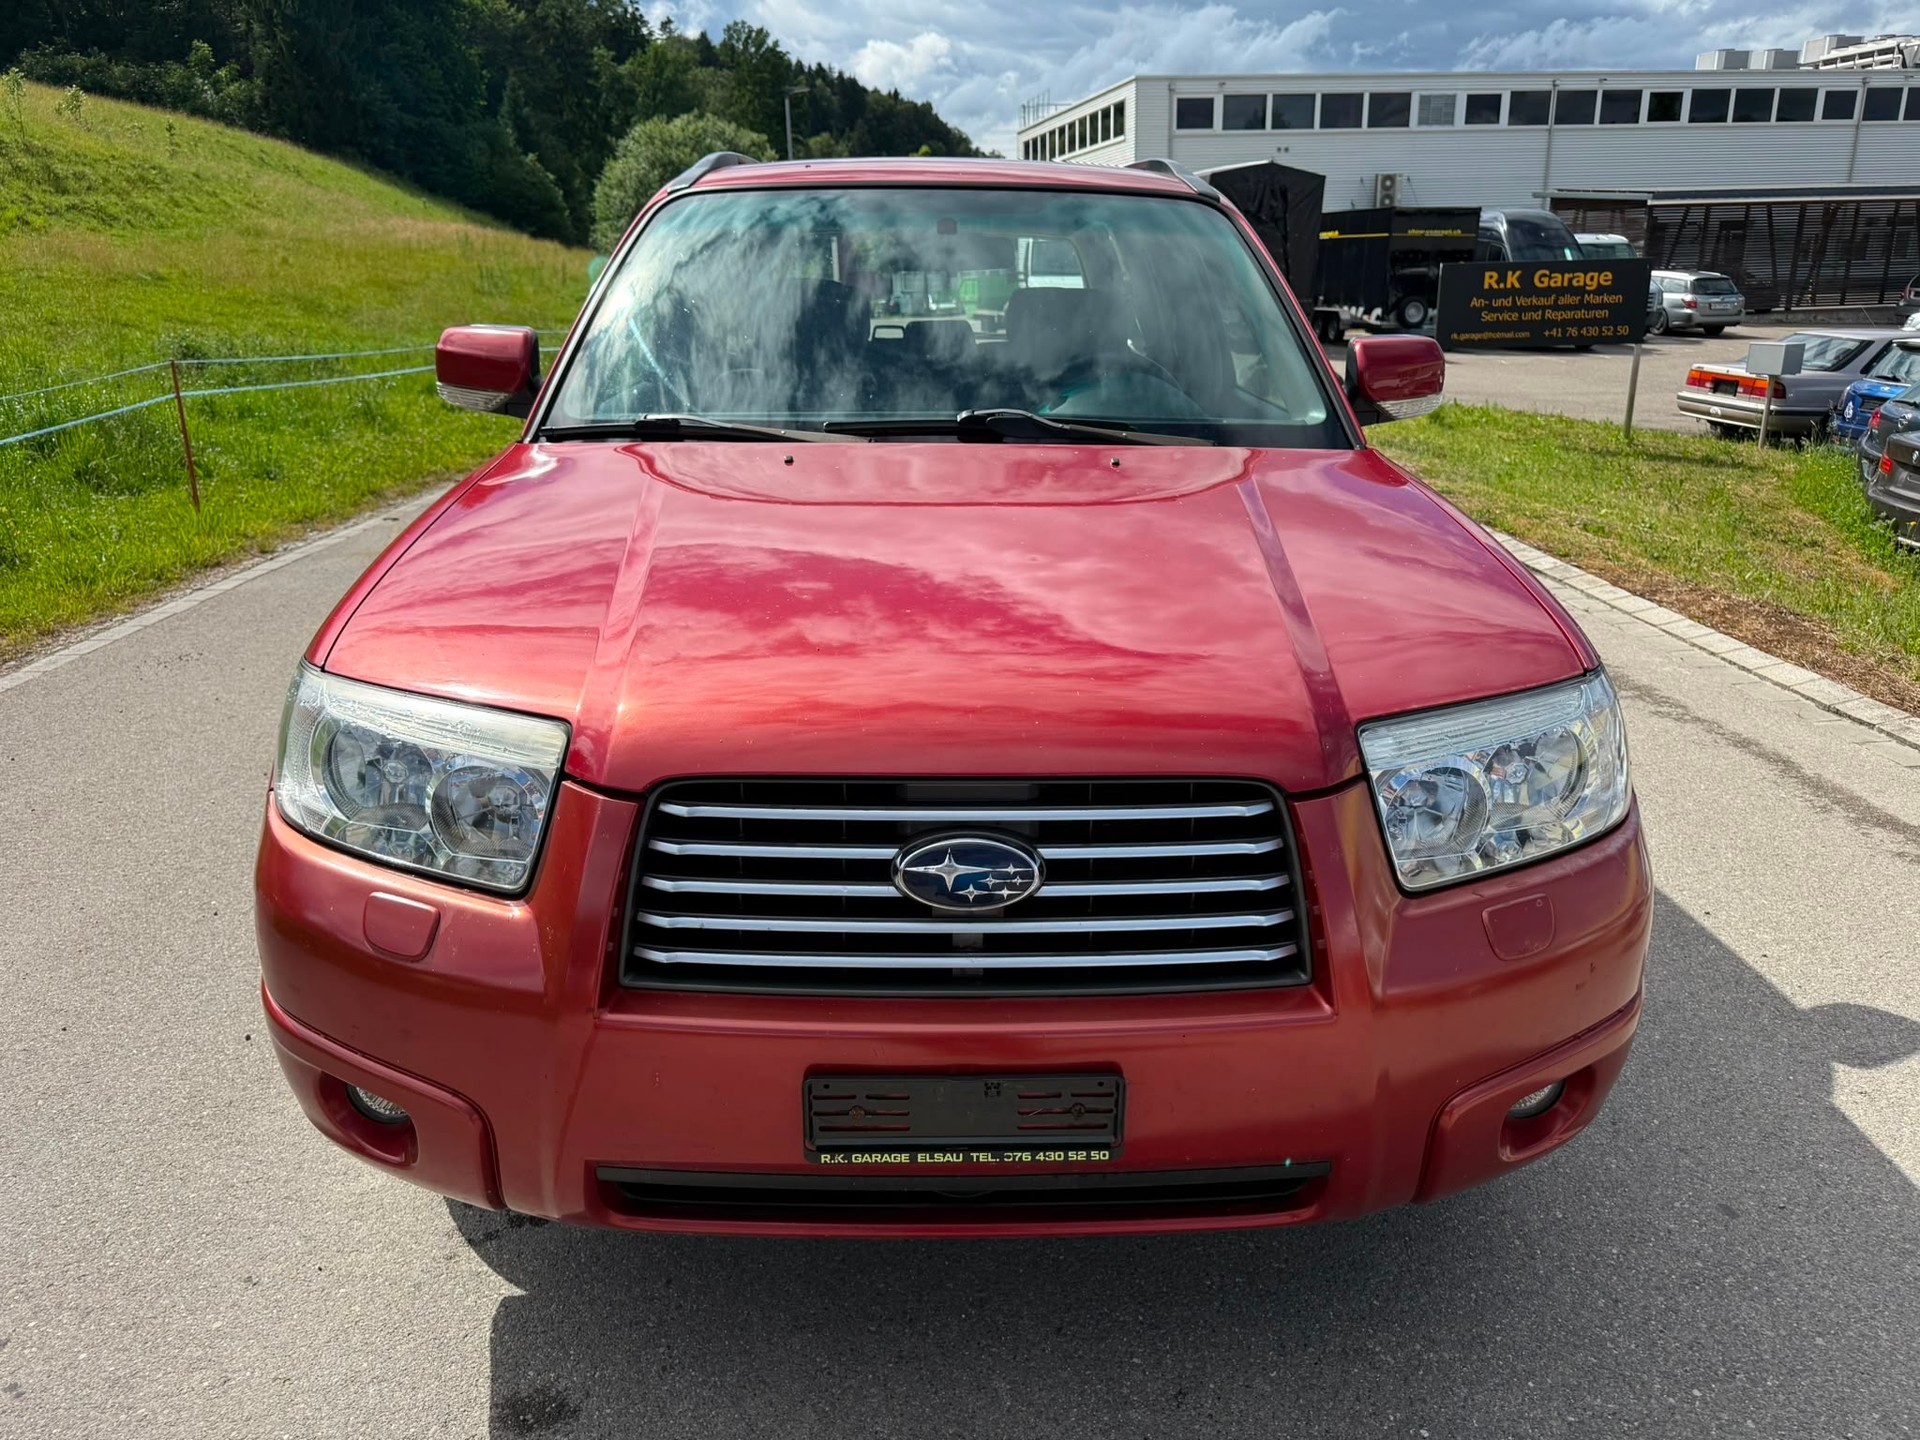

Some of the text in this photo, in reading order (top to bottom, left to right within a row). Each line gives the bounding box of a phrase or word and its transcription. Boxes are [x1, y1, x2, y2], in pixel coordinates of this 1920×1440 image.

[1484, 269, 1613, 290] R.K Garage
[1470, 292, 1623, 308] An- und Verkauf aller Marken
[1481, 308, 1609, 322] Service und Reparaturen
[1543, 325, 1629, 337] +41 76 430 52 50
[821, 1153, 848, 1164] R.K.
[851, 1153, 910, 1163] GARAGE
[917, 1152, 963, 1163] ELSAU
[970, 1152, 1000, 1162] TEL.
[1035, 1151, 1064, 1161] 430
[1068, 1151, 1087, 1161] 52
[1090, 1150, 1109, 1160] 50
